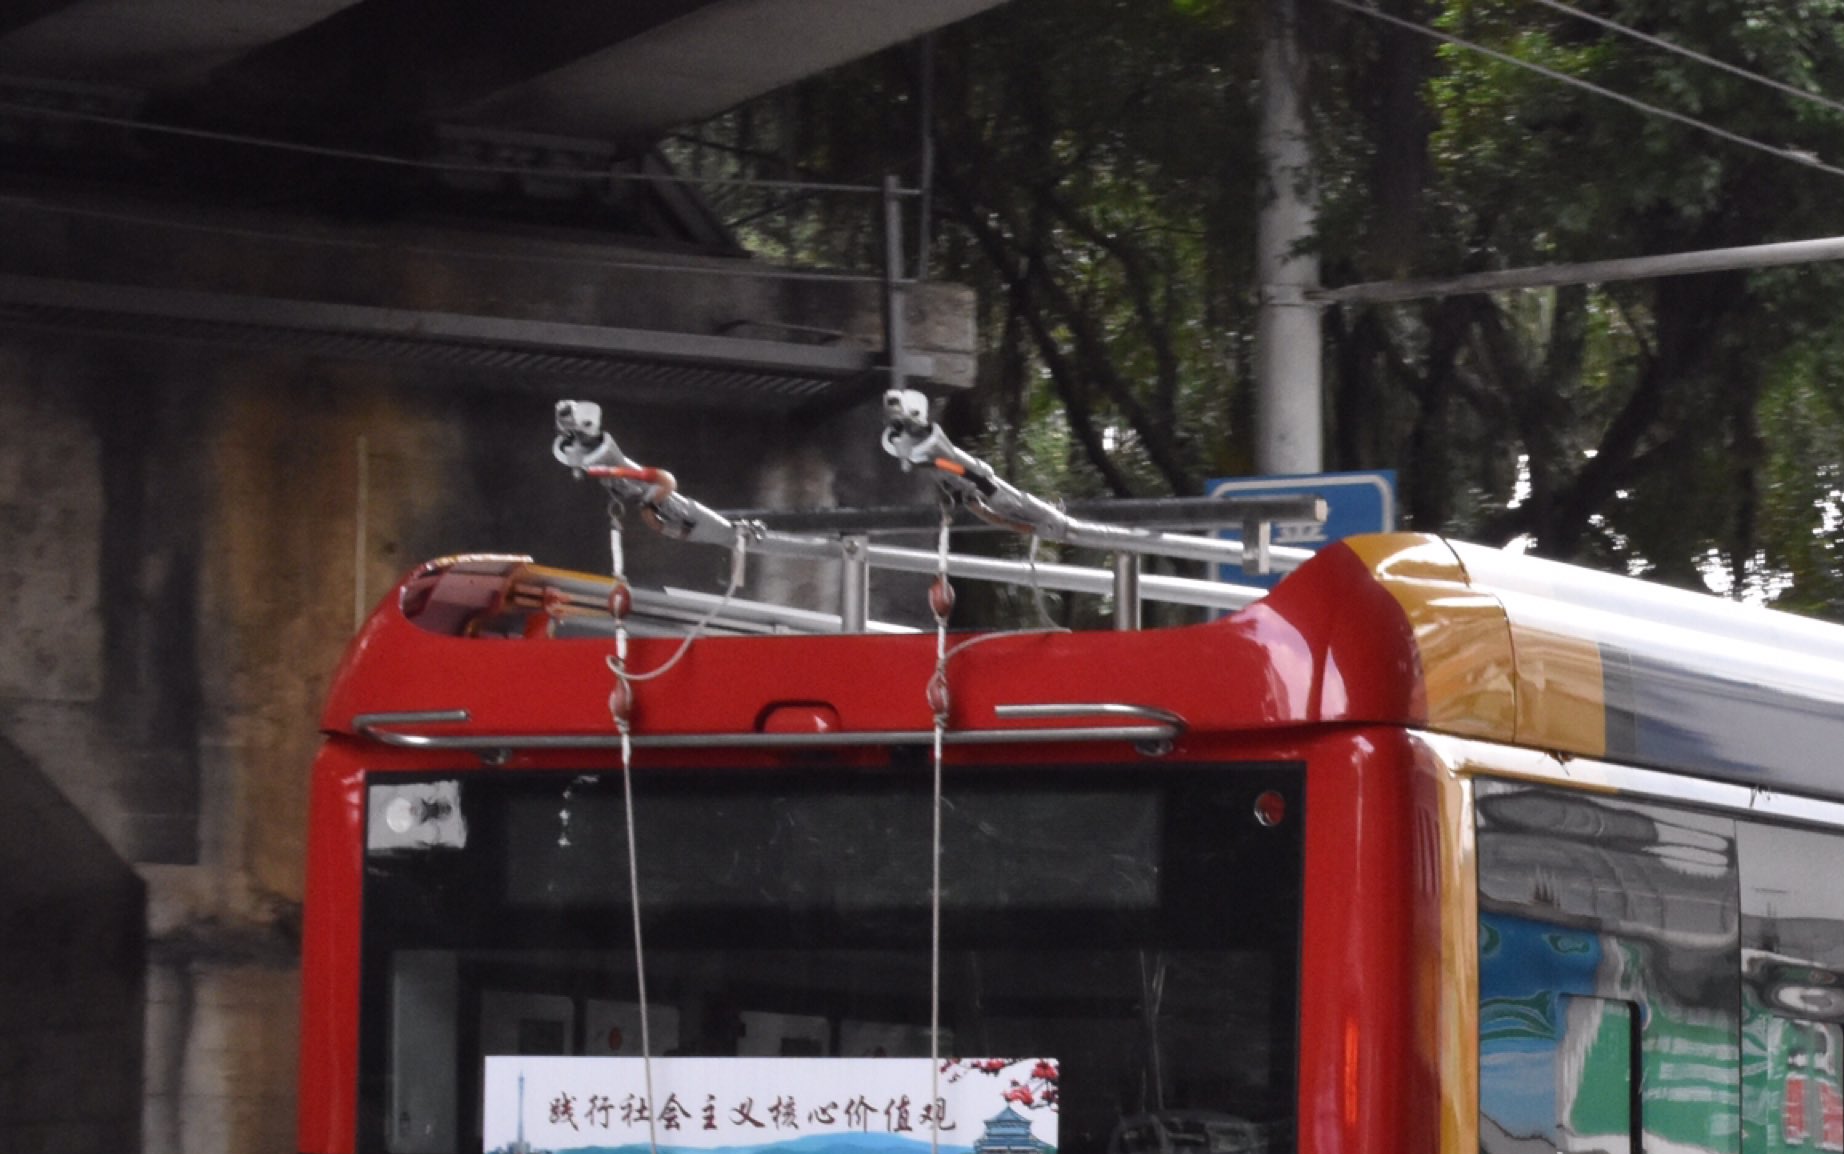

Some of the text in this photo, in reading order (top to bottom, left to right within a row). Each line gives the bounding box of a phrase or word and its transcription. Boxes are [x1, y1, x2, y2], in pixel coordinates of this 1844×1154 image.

[548, 1092, 957, 1133] 践行社会主义核心价值观
